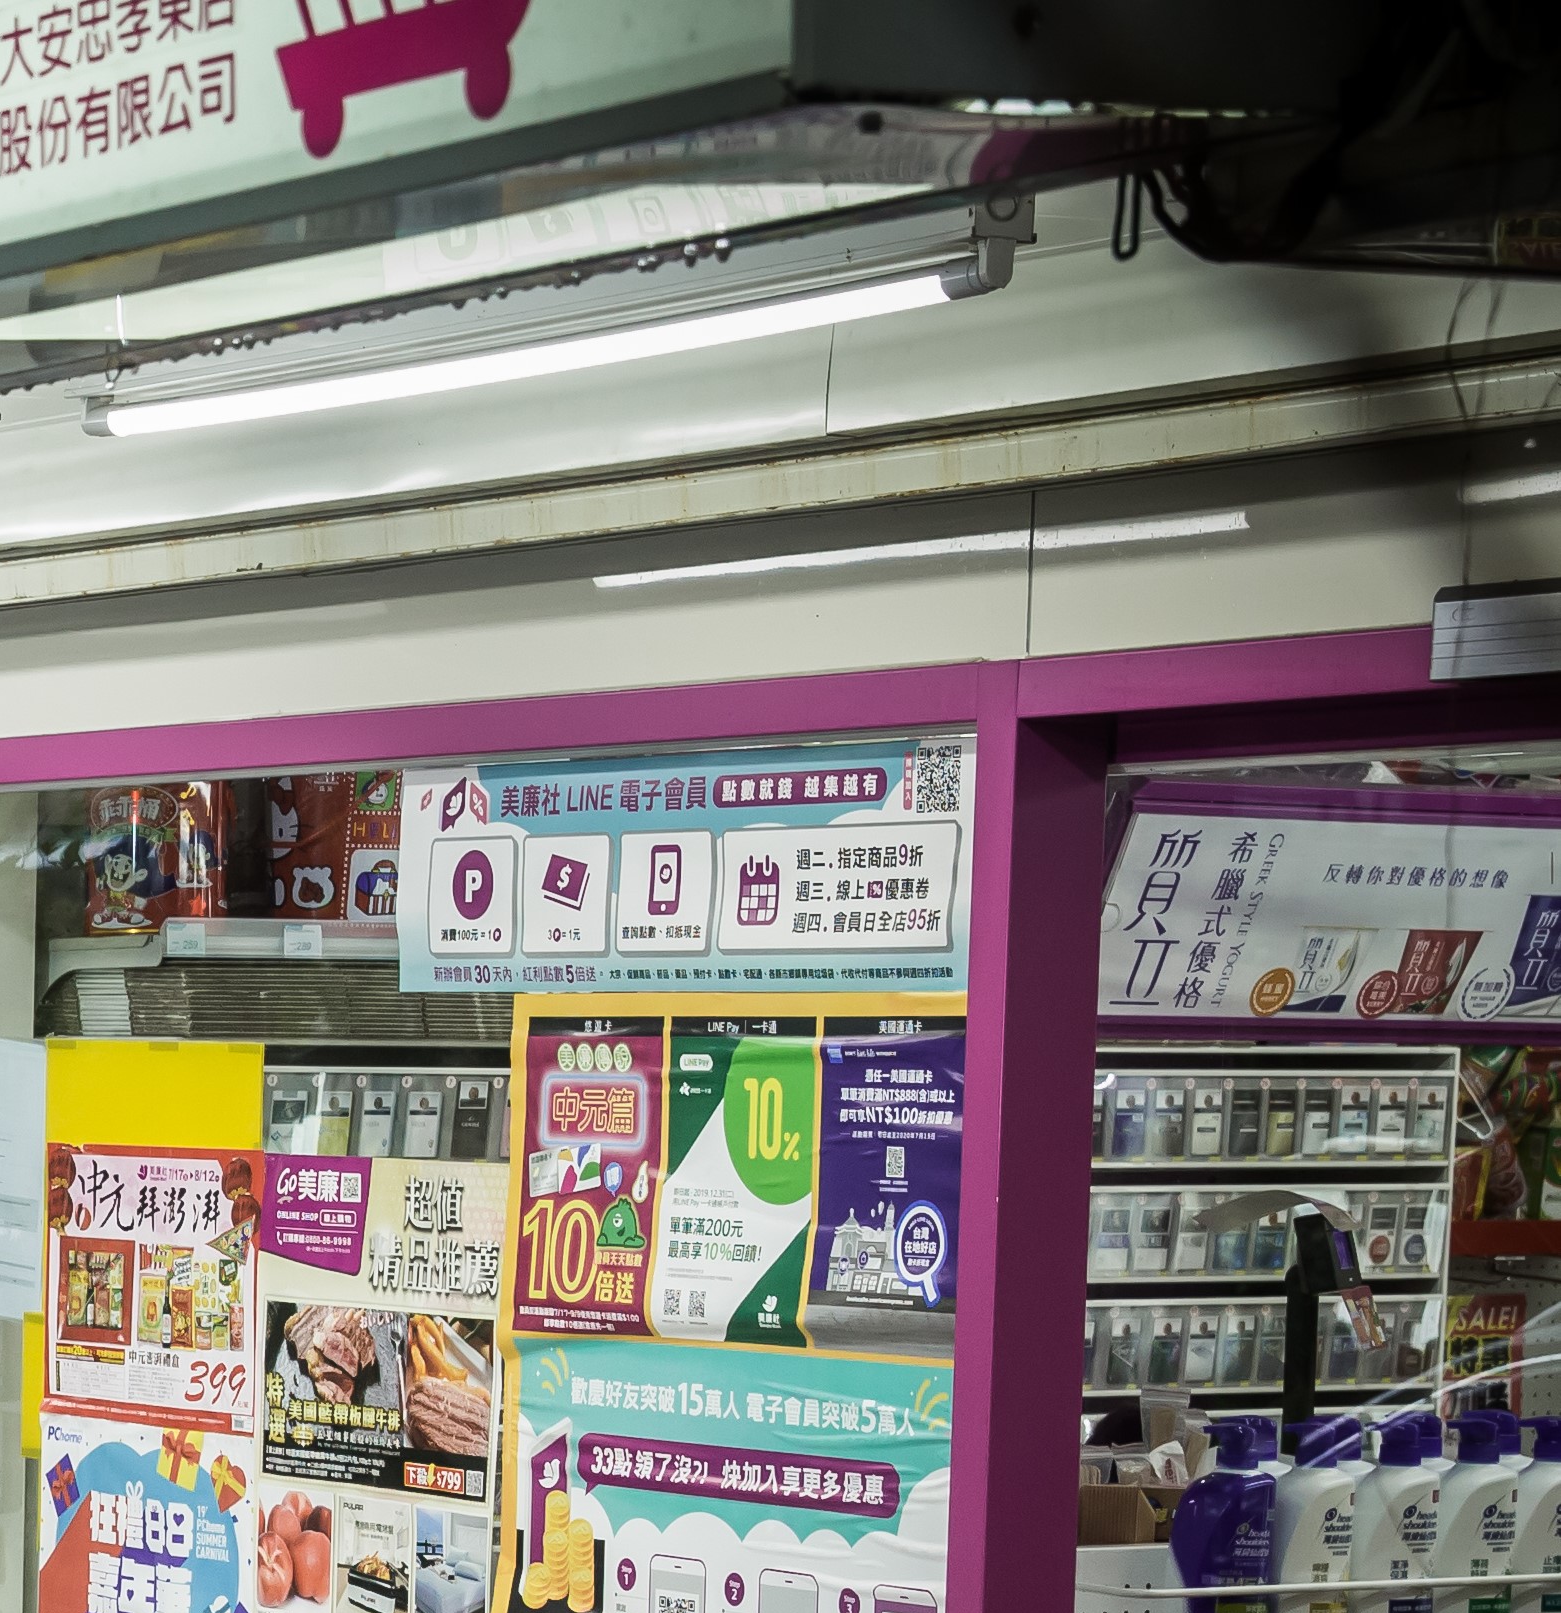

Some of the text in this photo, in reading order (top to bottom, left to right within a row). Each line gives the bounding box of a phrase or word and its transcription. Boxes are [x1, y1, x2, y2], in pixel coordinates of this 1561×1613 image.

[500, 776, 706, 818] 美廉社 LINE 電子會員
[1322, 863, 1509, 889] 反轉你對優格的想像
[1210, 833, 1285, 1008] GREEK STYLE YOGURT
[708, 1022, 725, 1032] LINE
[727, 1022, 740, 1034] Pay
[553, 1087, 634, 1134] 中元篇
[744, 1078, 799, 1161] 10%
[298, 1169, 339, 1202] 美廉
[277, 1211, 318, 1222] ONLINE SHOP
[404, 1174, 464, 1232] 超值
[670, 1217, 743, 1237] 單筆滿200元
[369, 1232, 500, 1296] 精品推薦
[523, 1199, 598, 1302] 10
[595, 1271, 634, 1304] 倍送
[1456, 1306, 1517, 1331] SALE!
[185, 1361, 246, 1406] 399
[571, 1377, 915, 1437] 歡慶好友突破15萬人 電子會員突破5萬人
[47, 1426, 82, 1444] PChome
[437, 1471, 461, 1490] $799
[720, 1460, 884, 1505] 快加入享更多優惠
[195, 1546, 230, 1563] CARNIVAL
[196, 1533, 227, 1548] SUMMER
